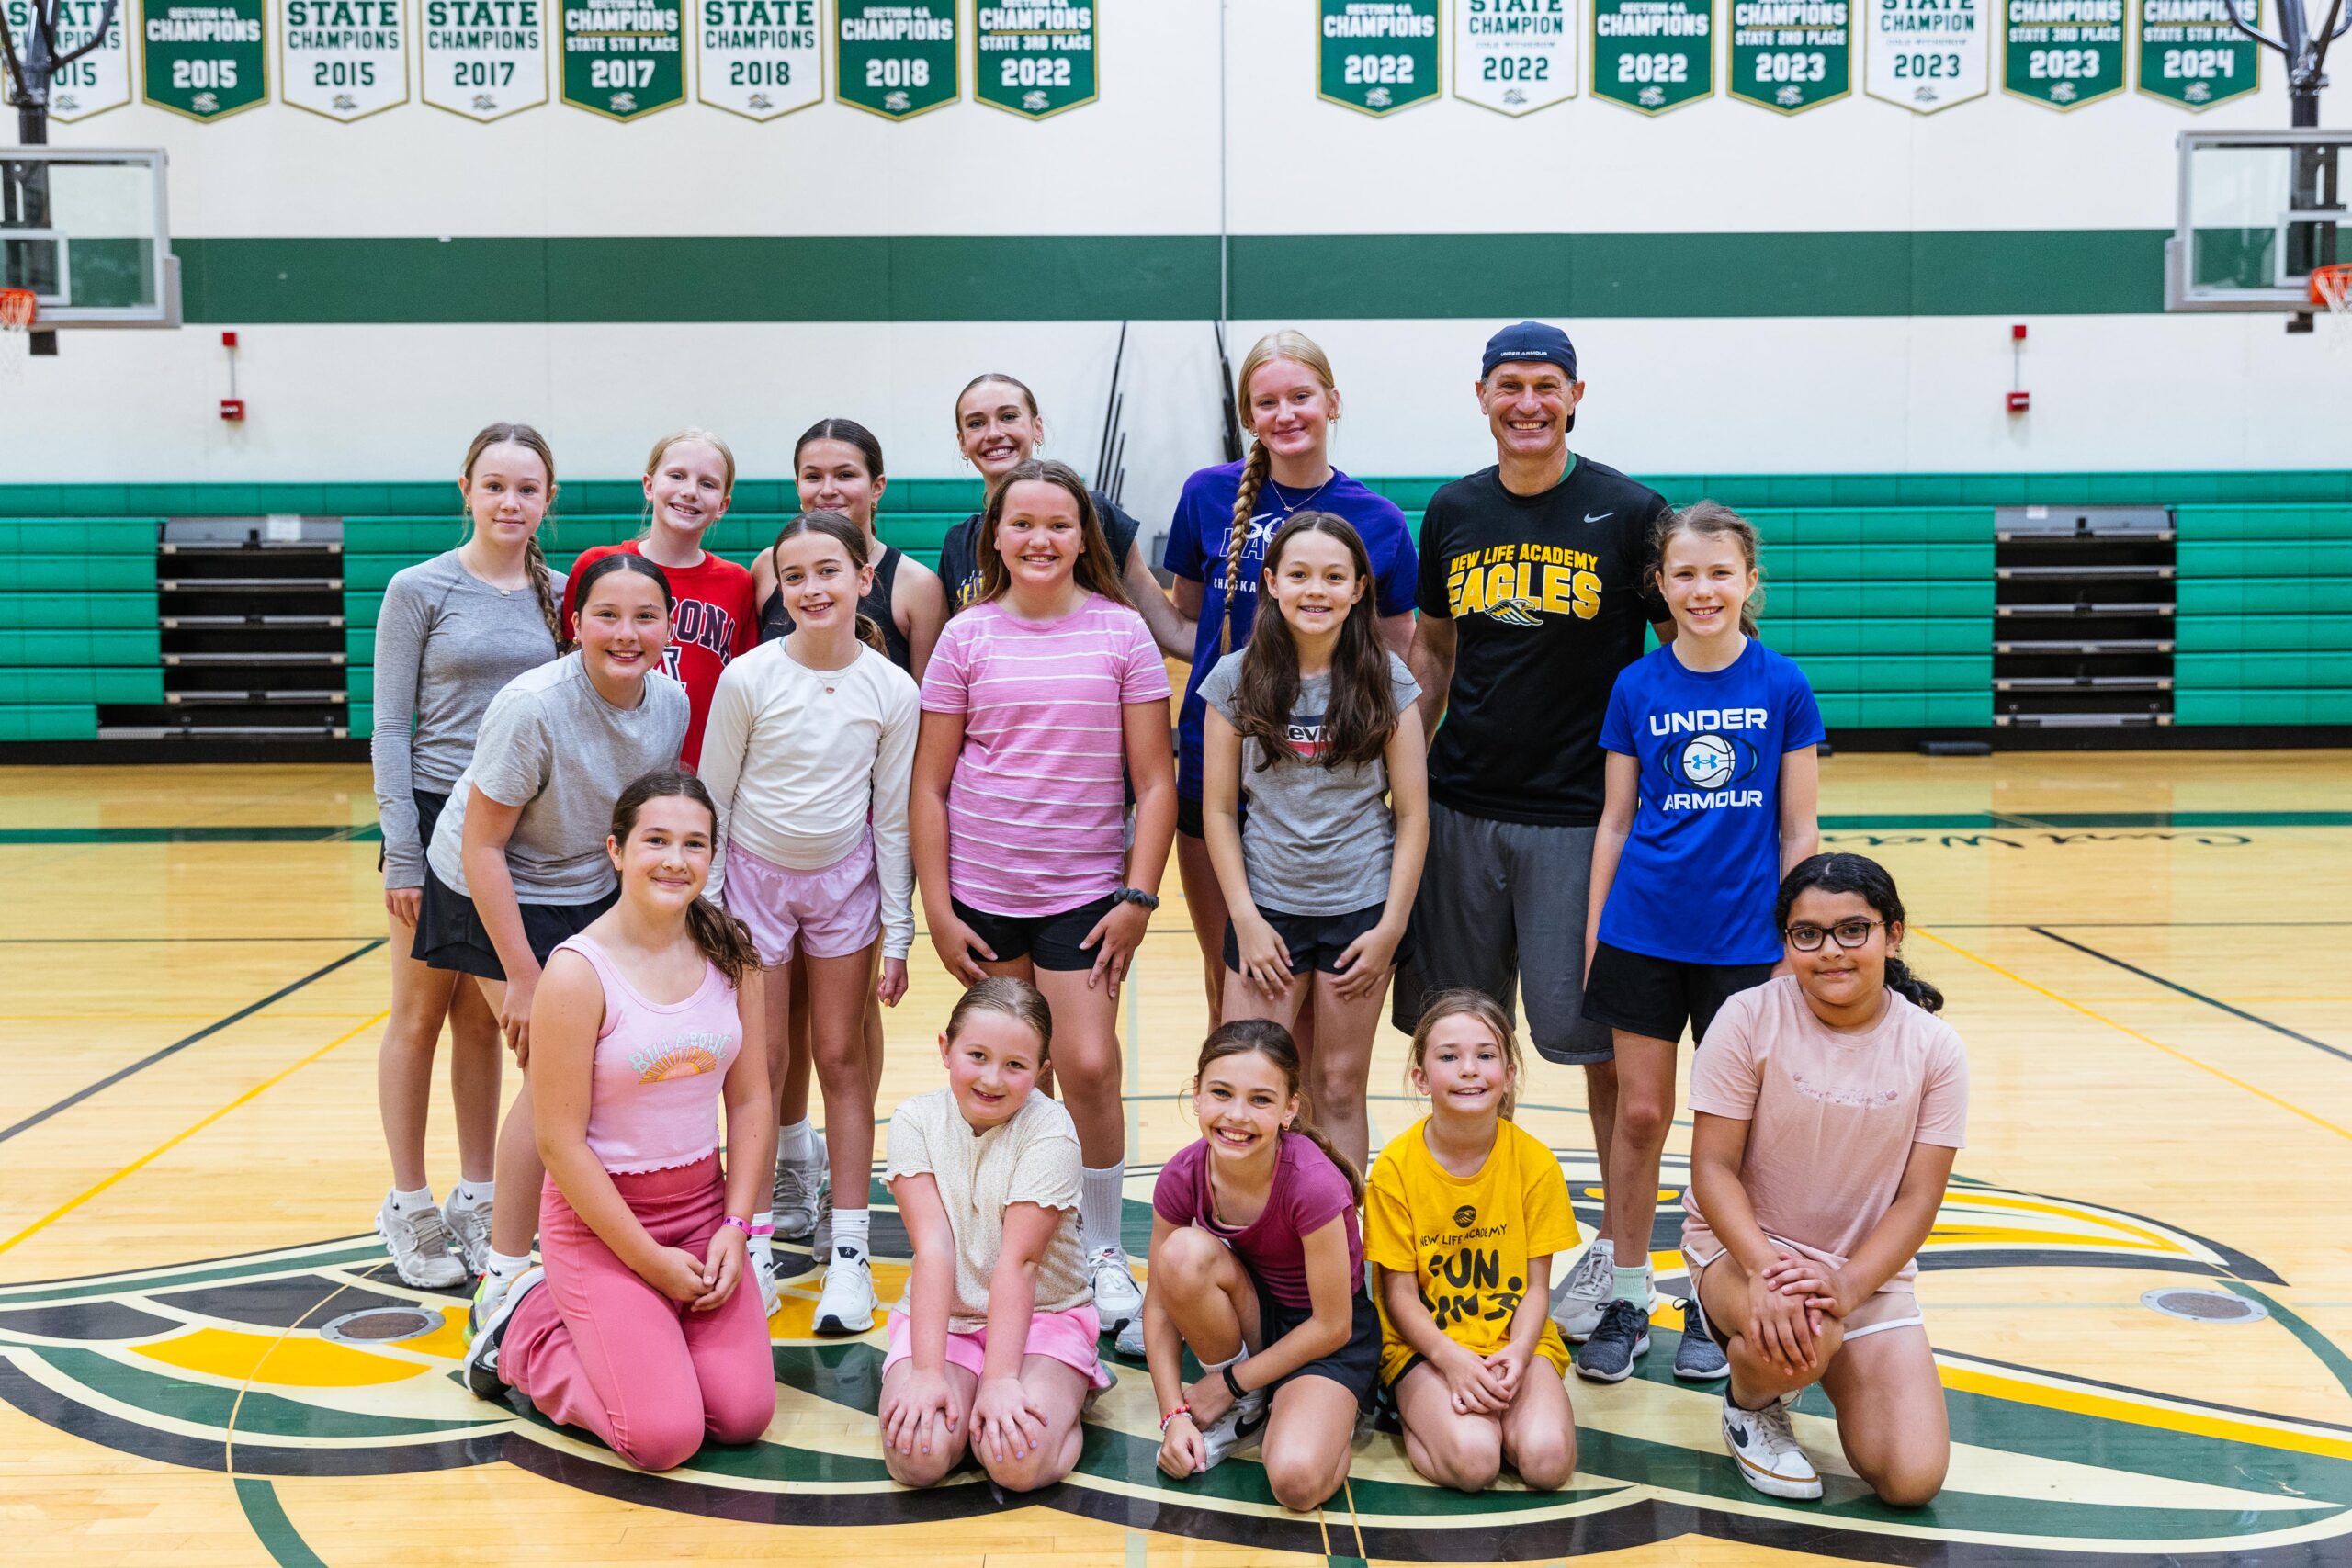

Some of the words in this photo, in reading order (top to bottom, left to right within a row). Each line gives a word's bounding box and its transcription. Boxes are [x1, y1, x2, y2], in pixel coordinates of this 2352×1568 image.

[168, 7, 219, 19] SECTION
[288, 1, 397, 26] STATE
[428, 1, 537, 26] STATE
[565, 8, 679, 31] CHAMPIONS
[705, 1, 814, 26] STATE
[863, 6, 910, 18] SECTION
[979, 7, 1091, 30] CHAMPIONS
[1345, 3, 1395, 15] SECTION
[1619, 2, 1668, 14] SECTION
[1735, 3, 1848, 26] CHAMPIONS
[2009, 0, 2122, 23] CHAMPIONS
[146, 19, 261, 42] CHAMPIONS
[841, 18, 954, 40] CHAMPIONS
[1323, 14, 1435, 38] CHAMPIONS
[1469, 17, 1563, 35] CHAMPION
[1597, 13, 1709, 37] CHAMPIONS
[1881, 14, 1974, 31] CHAMPION
[2008, 27, 2050, 43] STATE
[2052, 27, 2079, 42] 3RD
[2081, 26, 2121, 42] PLACE
[2143, 27, 2184, 42] STATE
[288, 31, 399, 50] CHAMPIONS
[428, 31, 538, 50] CHAMPIONS
[566, 36, 606, 52] STATE
[639, 36, 680, 52] PLACE
[705, 31, 815, 50] CHAMPIONS
[979, 35, 1020, 51] STATE
[1023, 35, 1049, 51] 3RD
[1052, 34, 1091, 51] PLACE
[1735, 29, 1775, 46] STATE
[1806, 29, 1847, 46] PLACE
[53, 62, 96, 86] 015
[172, 59, 238, 89] 2015
[313, 62, 375, 86] 2015
[454, 62, 515, 86] 2017
[590, 59, 656, 88] 2017
[729, 62, 791, 86] 2018
[865, 58, 930, 87] 2018
[1001, 58, 1071, 87] 2022
[1344, 55, 1415, 84] 2022
[1483, 57, 1550, 81] 2022
[1618, 53, 1689, 83] 2022
[1755, 52, 1826, 82] 2023
[1894, 54, 1961, 78] 2023
[2029, 49, 2100, 79] 2023
[2163, 49, 2234, 79] 2024
[1450, 550, 1481, 575] NEW
[1483, 544, 1516, 565] LIFE
[1519, 543, 1599, 572] ACADEMY
[1447, 562, 1602, 620] EAGLES
[1649, 707, 1768, 736] UNDER
[1662, 789, 1763, 811] ARMOUR
[1420, 1234, 1440, 1247] NEW
[1442, 1235, 1463, 1246] LIFE
[1464, 1224, 1507, 1240] ACADEMY
